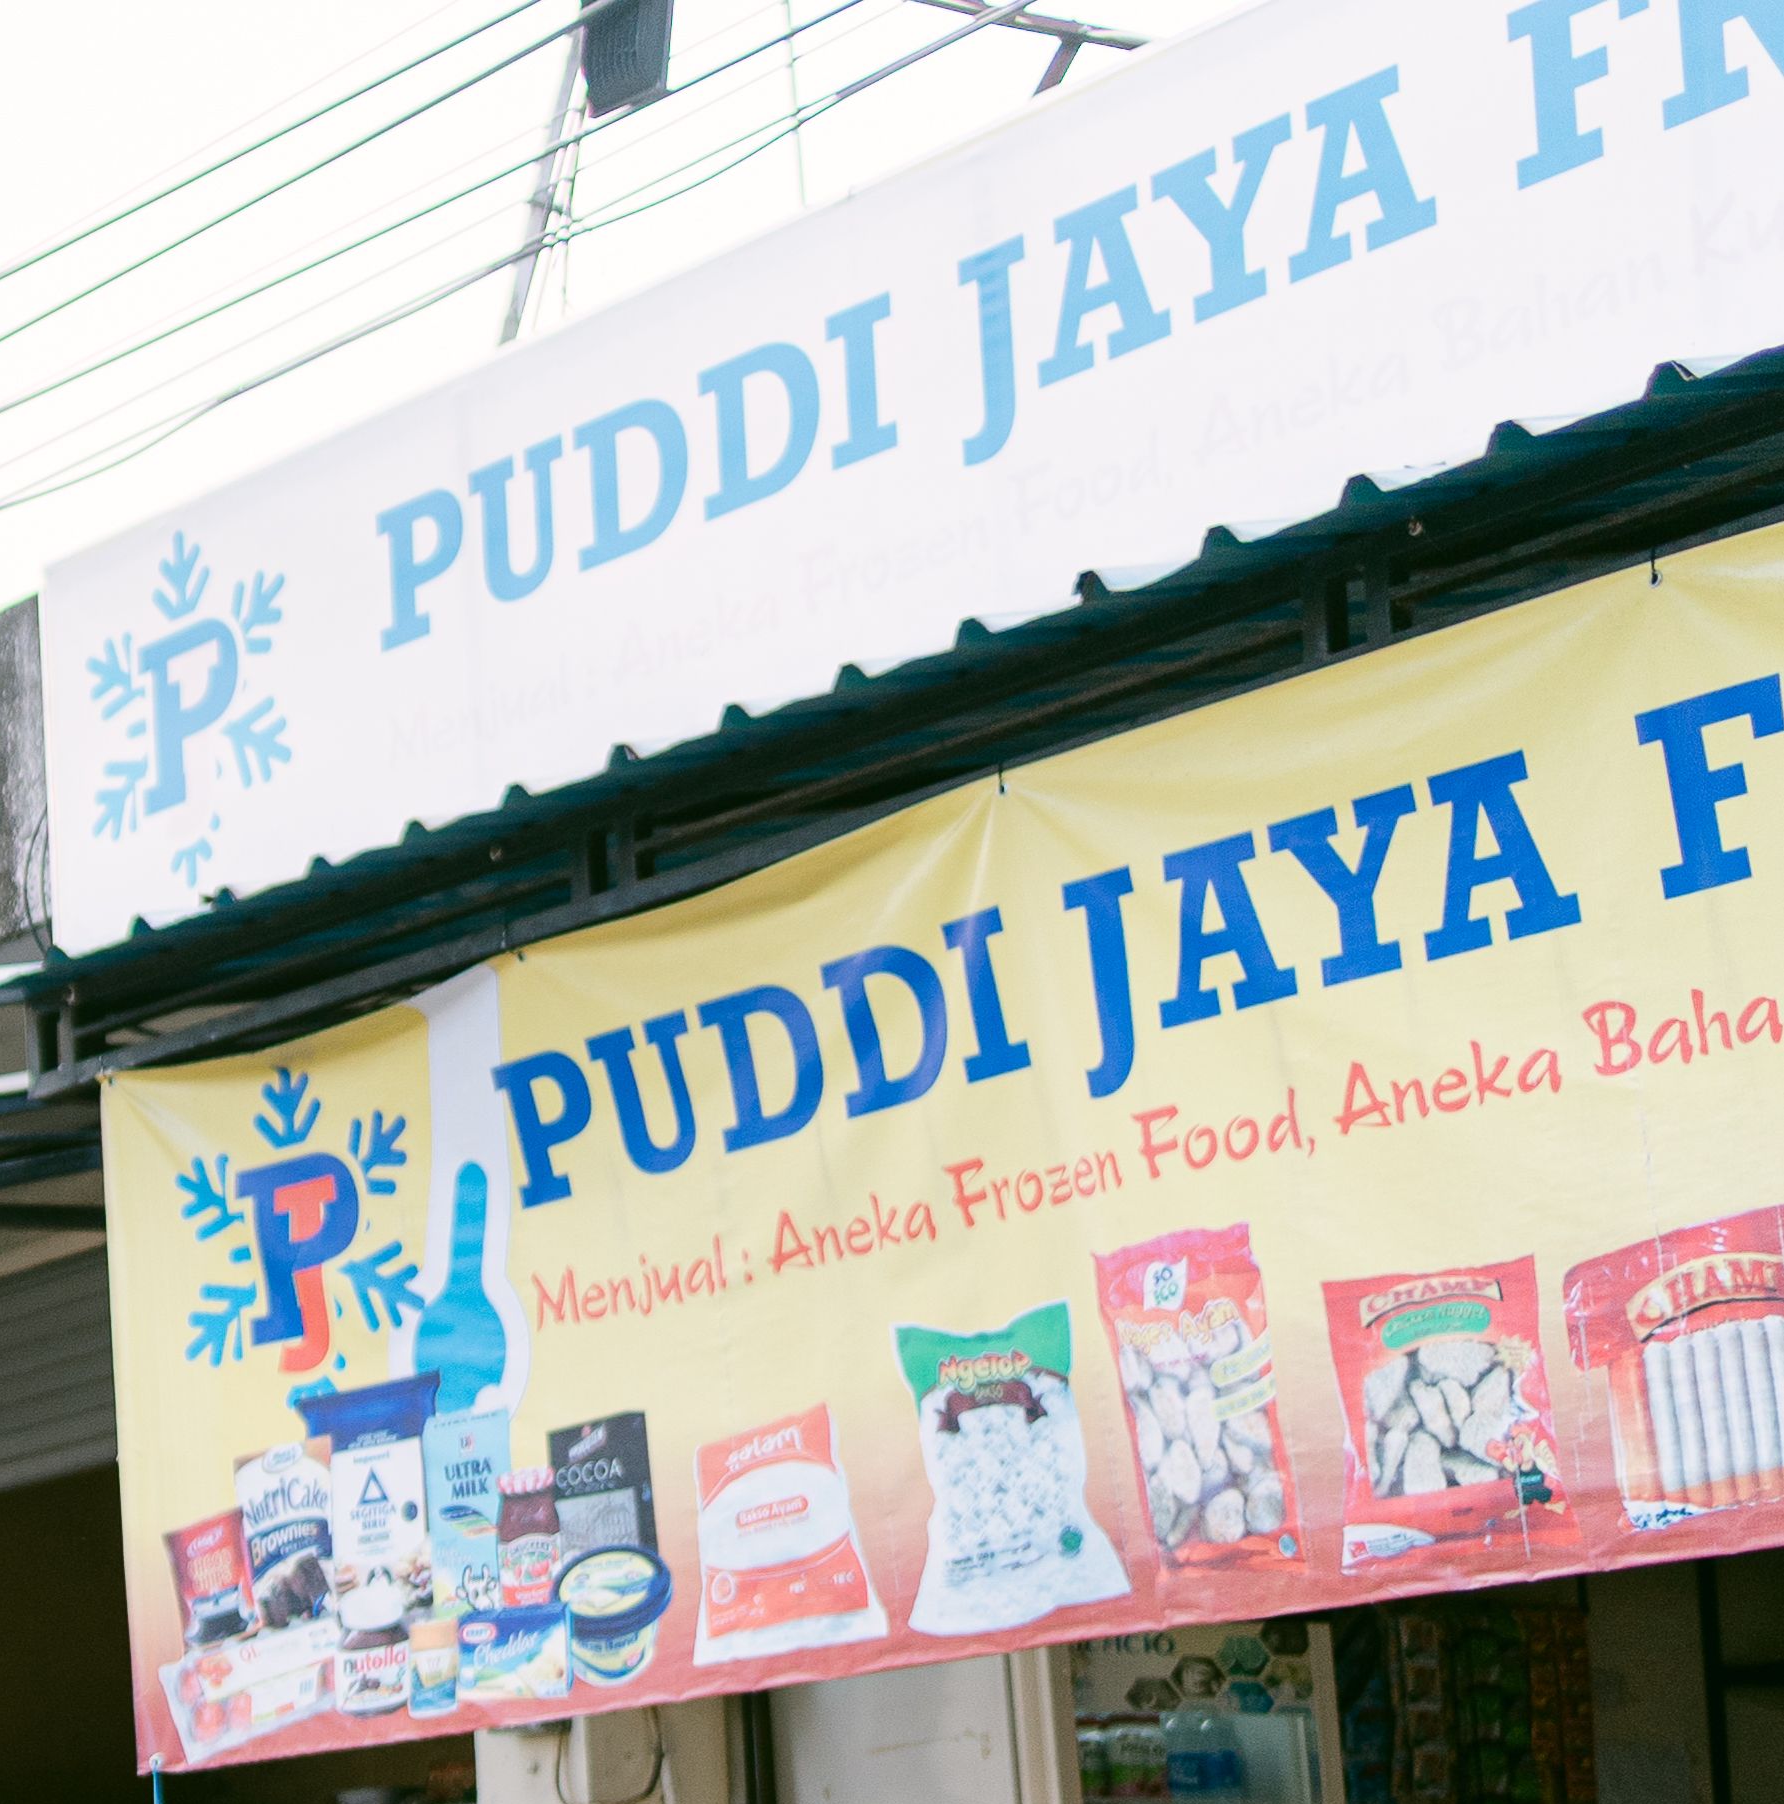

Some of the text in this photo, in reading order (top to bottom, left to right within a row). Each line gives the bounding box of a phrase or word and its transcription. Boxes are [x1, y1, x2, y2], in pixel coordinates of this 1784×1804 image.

[377, 292, 899, 650] PUDDI
[958, 63, 1438, 467] JAYA
[613, 588, 783, 686] Aneka
[798, 512, 992, 616] Frozen
[1194, 344, 1415, 472] Aneka
[1434, 252, 1670, 376] Bahan
[493, 673, 1784, 1209] PUDDI JAYA F
[530, 1233, 728, 1332] Menjual
[769, 1192, 938, 1274] Aneka
[943, 1151, 1124, 1229] Frozen
[1131, 1087, 1317, 1180] Food,
[1333, 1039, 1563, 1136] Aneka
[1367, 1278, 1494, 1314] CHAMP
[1635, 1258, 1784, 1323] CHAM
[444, 1457, 493, 1482] ULTRA
[451, 1478, 490, 1500] MILK
[555, 1456, 624, 1488] COCOA
[250, 1521, 318, 1568] Brownies
[343, 1643, 407, 1677] nutella
